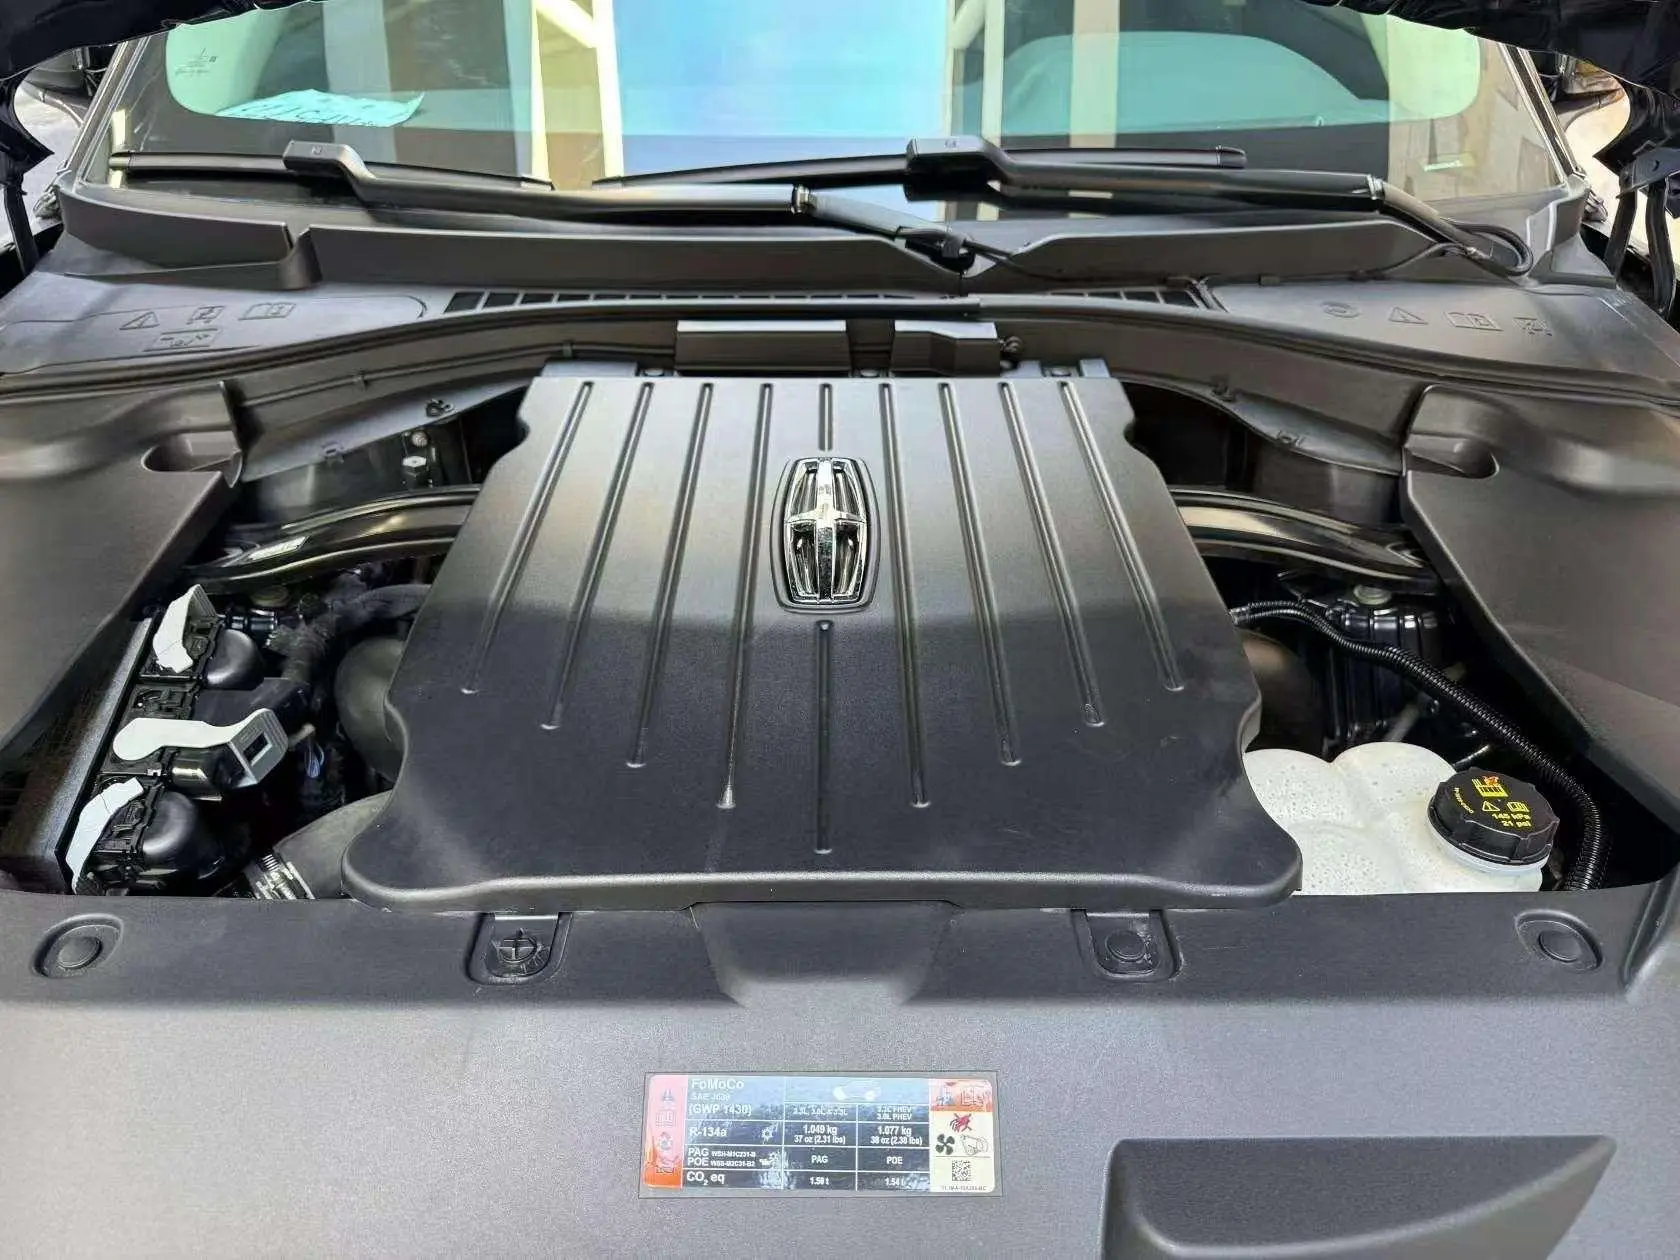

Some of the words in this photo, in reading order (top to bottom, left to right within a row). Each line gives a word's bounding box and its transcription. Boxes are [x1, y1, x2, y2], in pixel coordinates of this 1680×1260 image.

[1515, 820, 1532, 828] psi
[691, 1078, 745, 1090] FoMoCo
[688, 1103, 721, 1116] (GWP
[723, 1103, 752, 1117] 1430)
[689, 1126, 728, 1137] R-134a
[803, 1124, 826, 1134] 1.049
[826, 1124, 838, 1136] kg
[878, 1125, 900, 1135] 1.077
[901, 1125, 912, 1137] kg
[794, 1135, 803, 1143] 37
[814, 1135, 831, 1144] (2.31
[688, 1147, 709, 1157] PAG
[687, 1157, 709, 1167] POE
[811, 1155, 829, 1164] PAG
[886, 1156, 903, 1165] POE
[710, 1173, 726, 1185] eq
